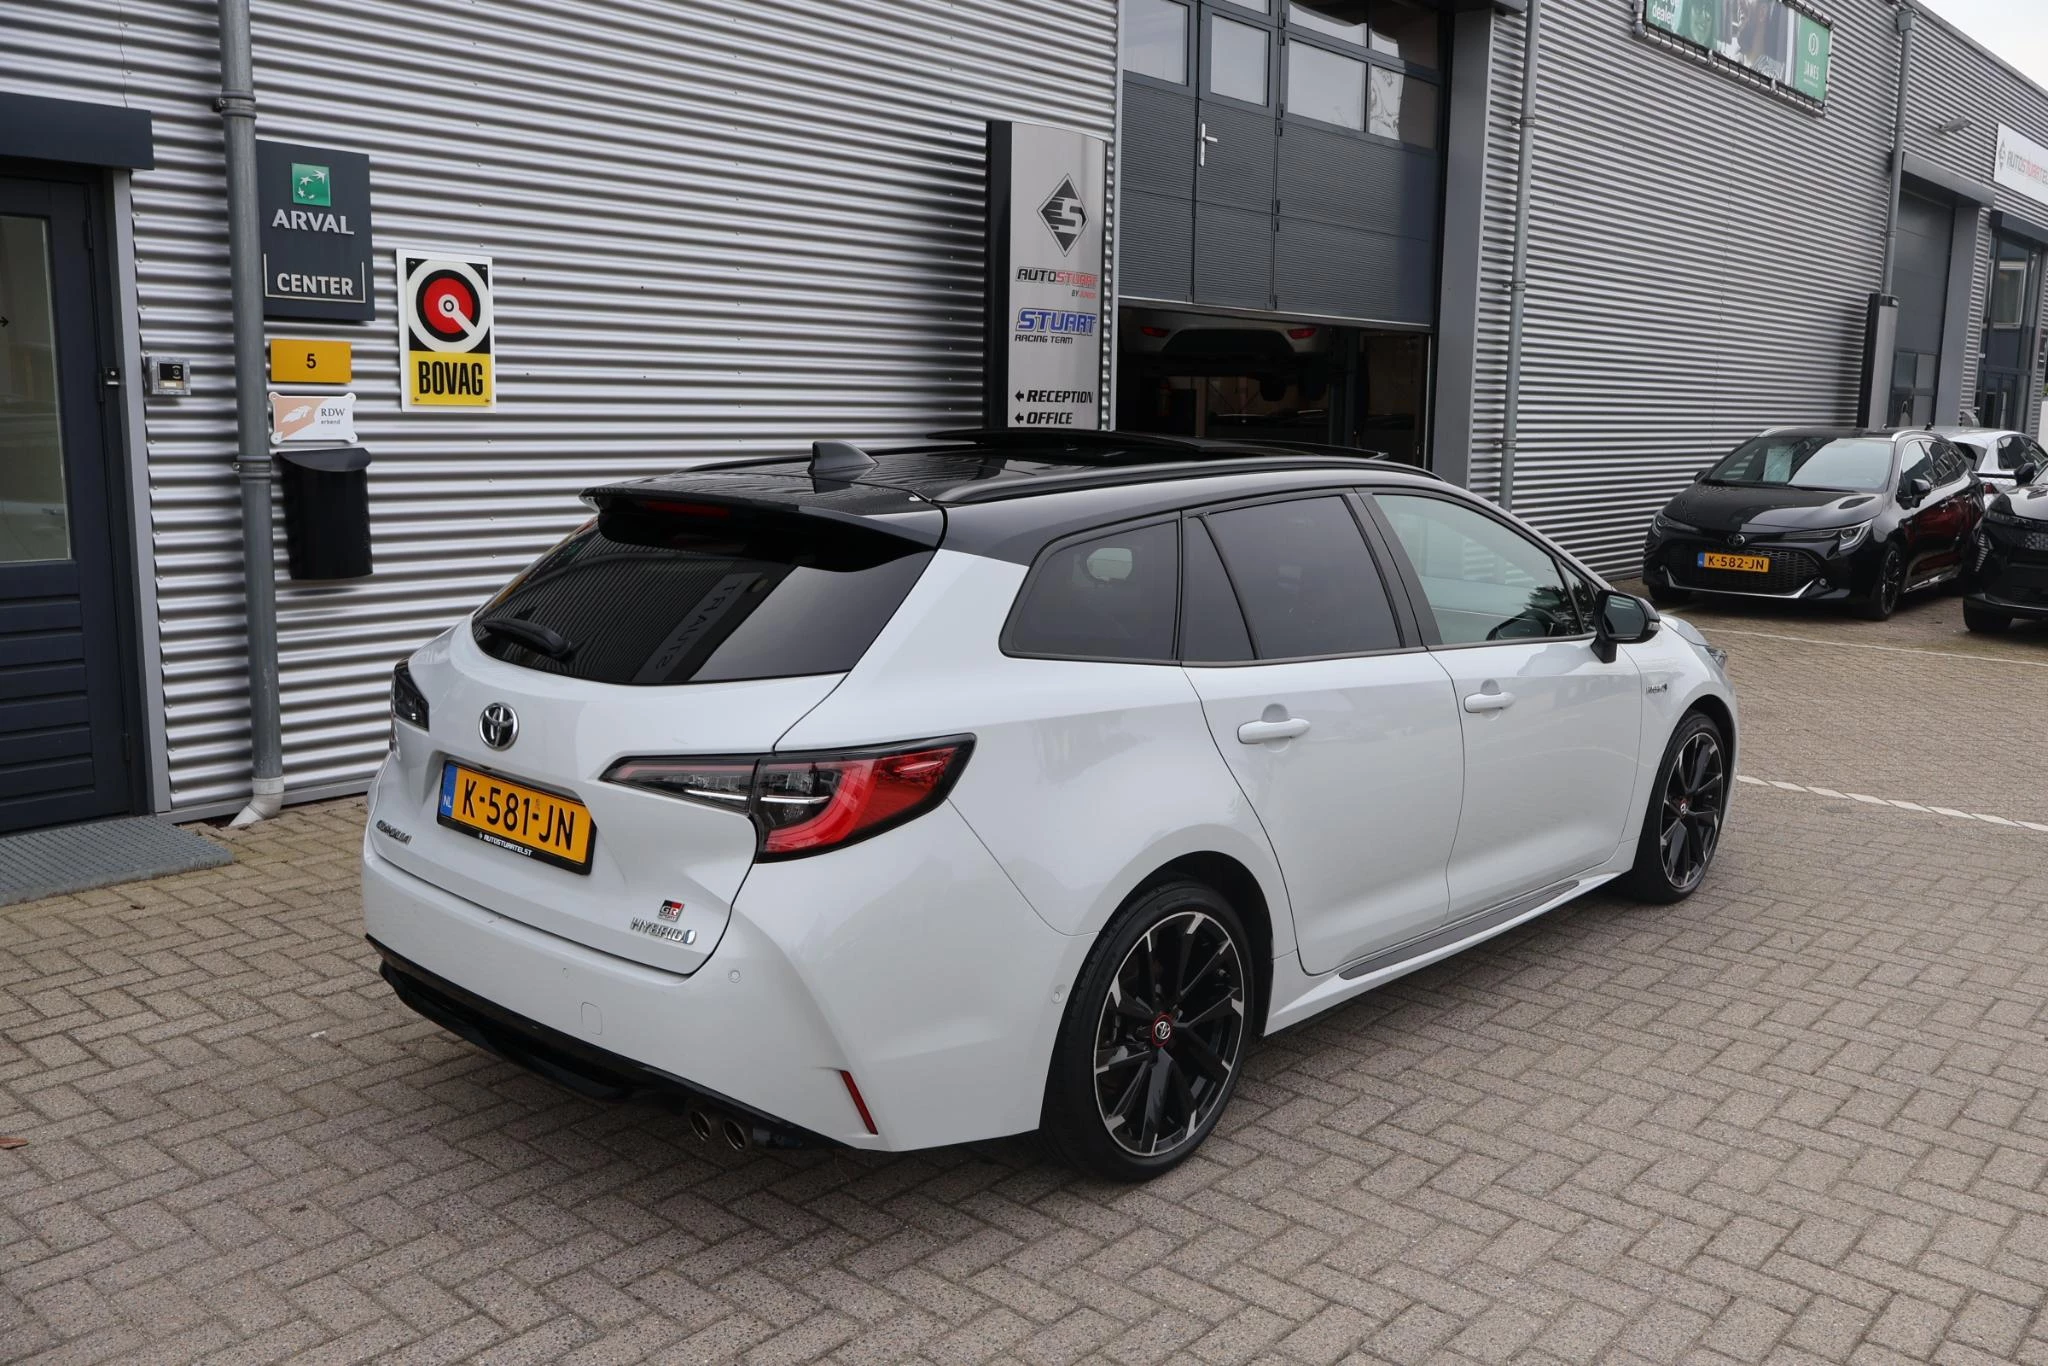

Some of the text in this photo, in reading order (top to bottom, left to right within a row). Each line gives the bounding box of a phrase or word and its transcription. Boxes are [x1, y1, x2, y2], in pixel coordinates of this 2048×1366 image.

[272, 209, 355, 235] ARVAL
[277, 273, 354, 296] CENTER
[1017, 267, 1097, 288] AUTOSTUART
[1017, 309, 1097, 335] STUART
[1015, 334, 1073, 344] RACING TEAM
[306, 353, 317, 369] 5
[418, 361, 483, 396] BOVAG
[1027, 389, 1094, 404] RECEPTION
[321, 407, 346, 417] RDW
[1027, 411, 1073, 425] OFFICE
[1708, 555, 1764, 570] K-582-JN
[442, 794, 452, 808] NL
[462, 778, 575, 851] K-581-JN
[661, 905, 679, 916] GR
[630, 916, 683, 943] HYBRID
